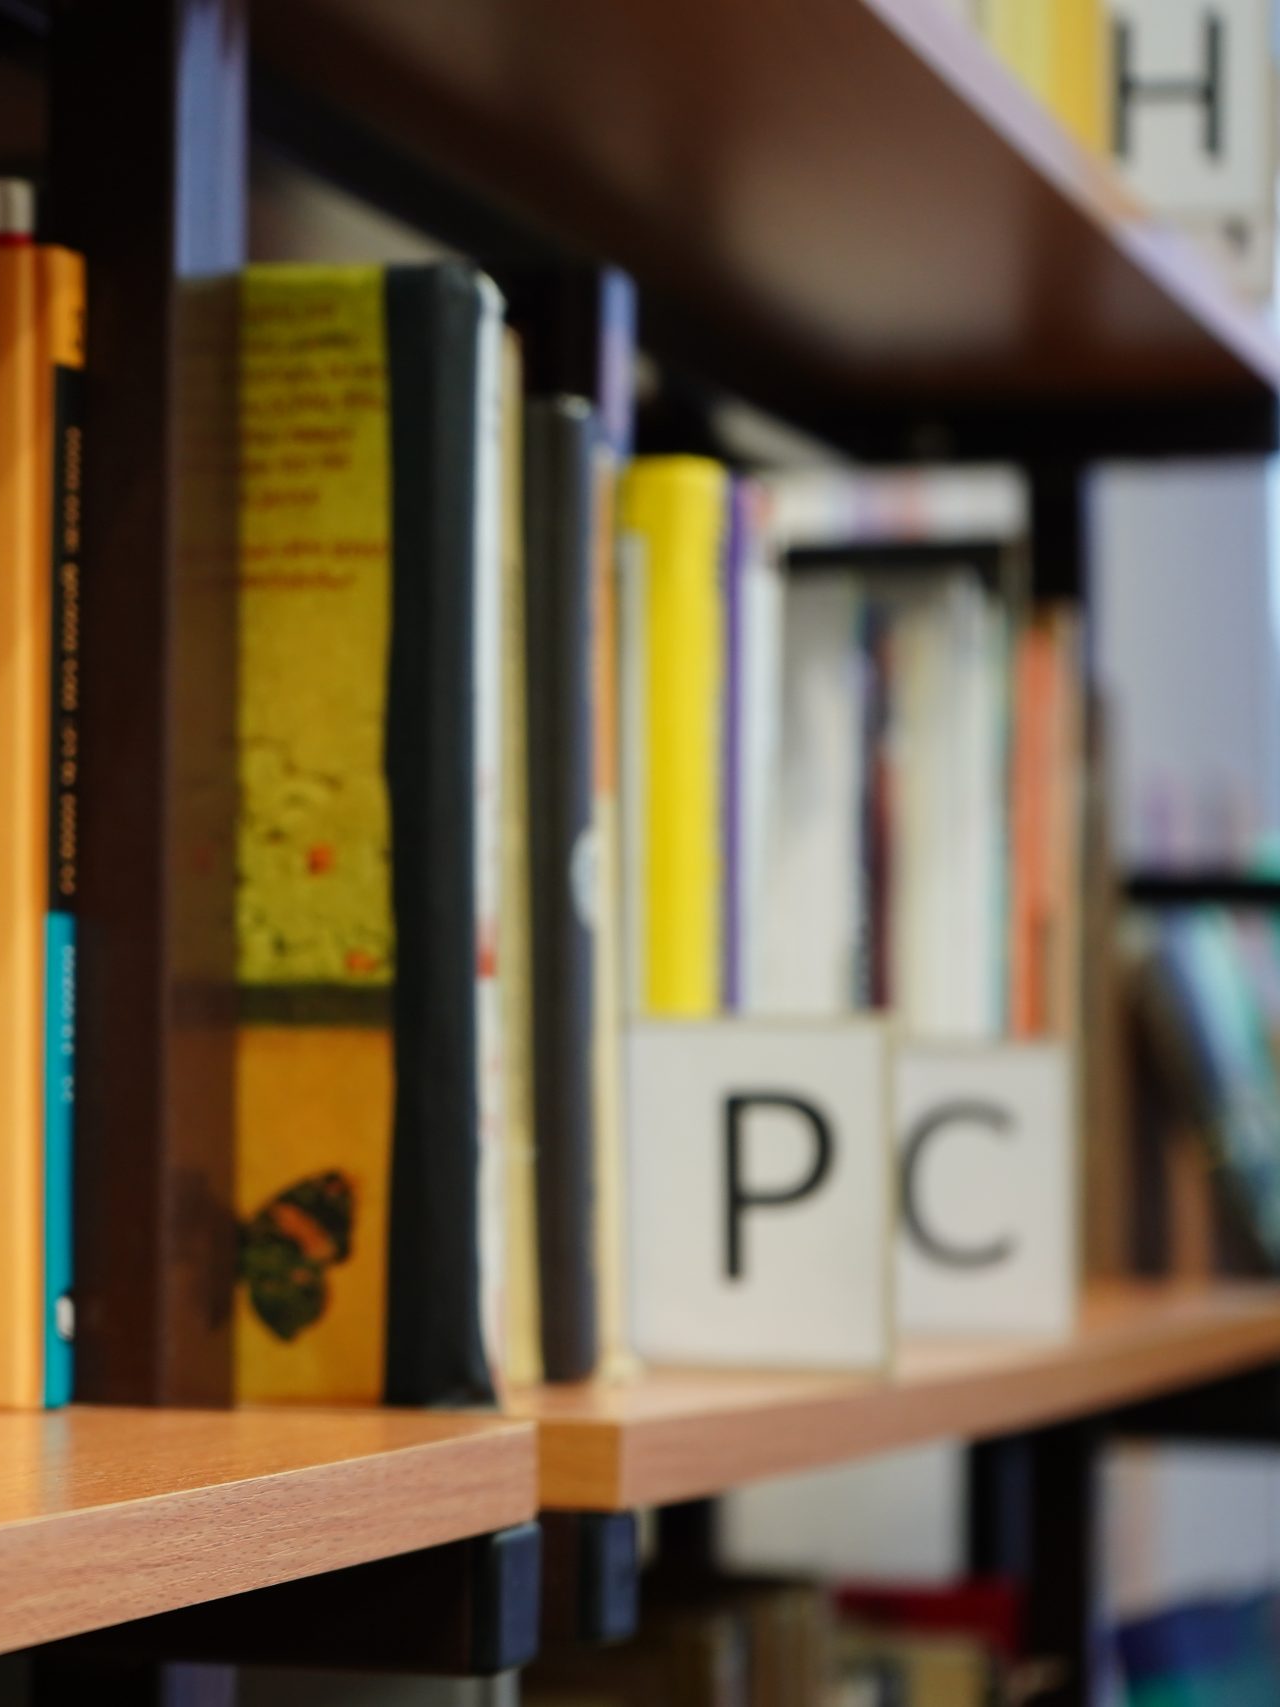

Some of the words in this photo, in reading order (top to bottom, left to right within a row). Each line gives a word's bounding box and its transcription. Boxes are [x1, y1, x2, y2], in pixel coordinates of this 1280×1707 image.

[1110, 9, 1226, 164] Н
[720, 1091, 836, 1281] Р
[900, 1100, 1015, 1271] С
